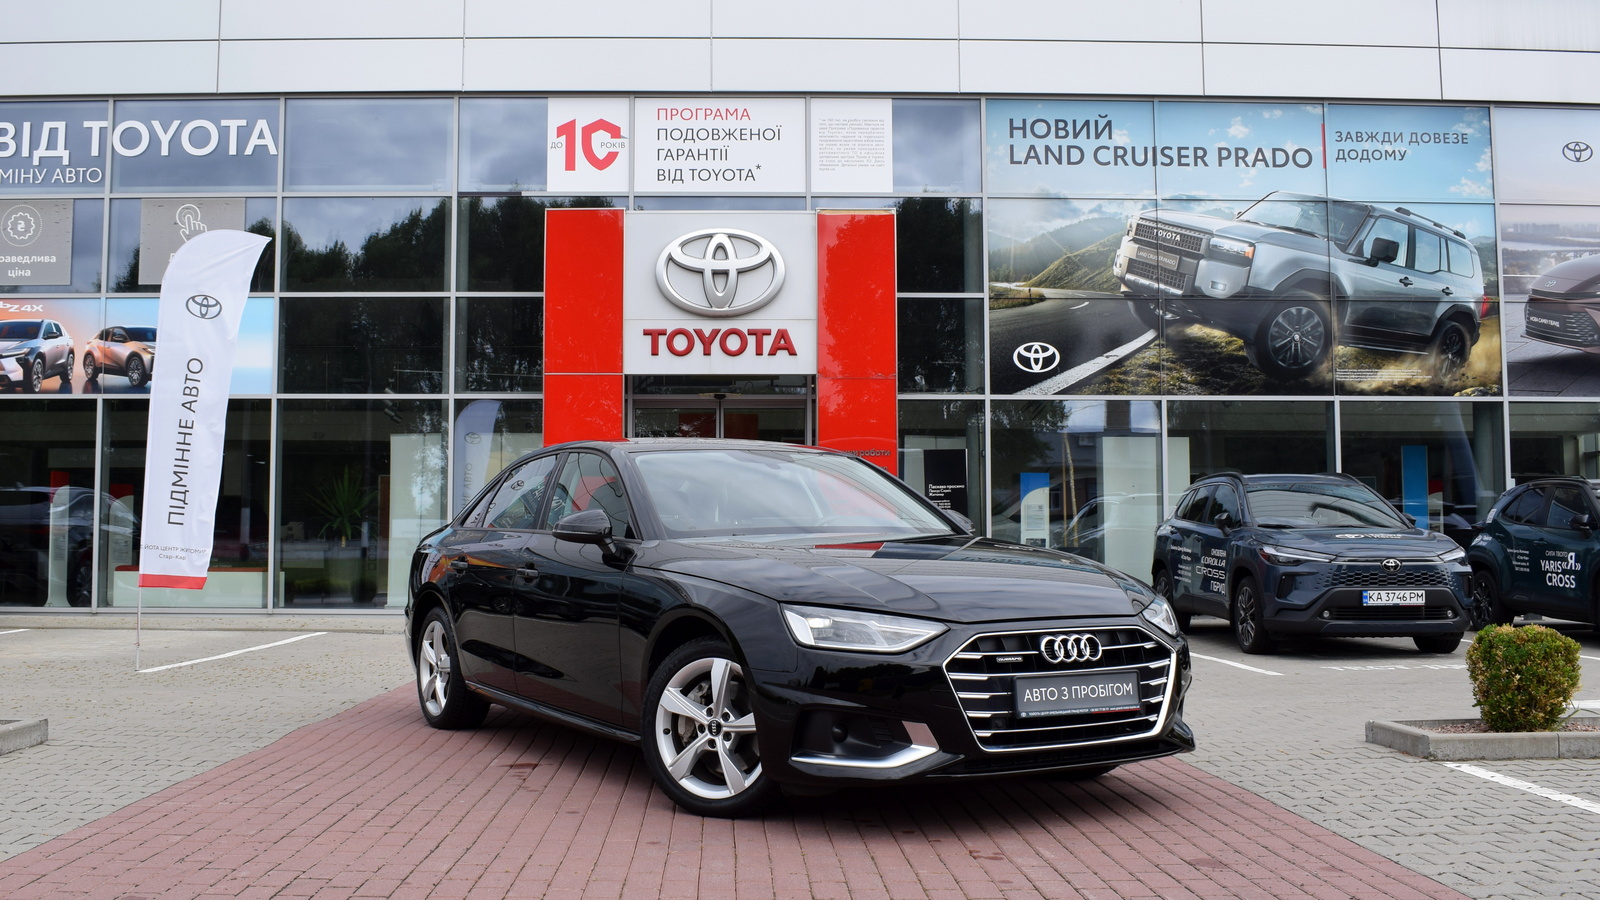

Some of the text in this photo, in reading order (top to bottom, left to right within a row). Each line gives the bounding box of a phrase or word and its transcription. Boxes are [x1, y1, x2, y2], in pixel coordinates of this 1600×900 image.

[657, 108, 751, 121] ПРОГРАМА
[657, 125, 783, 143] ПОДОВЖЕНОЇ
[1009, 113, 1113, 141] НОВИЙ
[83, 119, 279, 157] TOYOTA
[550, 142, 563, 150] ДО
[600, 141, 626, 149] РОКІВ
[1335, 131, 1469, 146] ЗАВЖДИ ДОВЕЗЕ
[657, 146, 730, 162] ГАРАНТІЇ
[1009, 144, 1314, 169] LAND CRUISER PRADO
[1335, 149, 1407, 163] ДОДОМУ
[52, 167, 102, 184] АВТО
[657, 169, 685, 185] ВІД
[1154, 229, 1181, 242] TOYOTA
[8, 267, 32, 278] ціна
[643, 328, 797, 357] TOYOTA
[168, 357, 204, 526] ПІДМІННЕ АВТО
[860, 448, 891, 458] роботи
[1201, 556, 1226, 568] COROLLA
[1540, 560, 1562, 573] YARIS
[1196, 565, 1226, 580] CROSS
[1546, 573, 1576, 589] CROSS
[1368, 592, 1424, 602] KA 3746 PM
[1024, 687, 1058, 703] АВТО
[1072, 683, 1133, 700] ПРОБІГОМ
